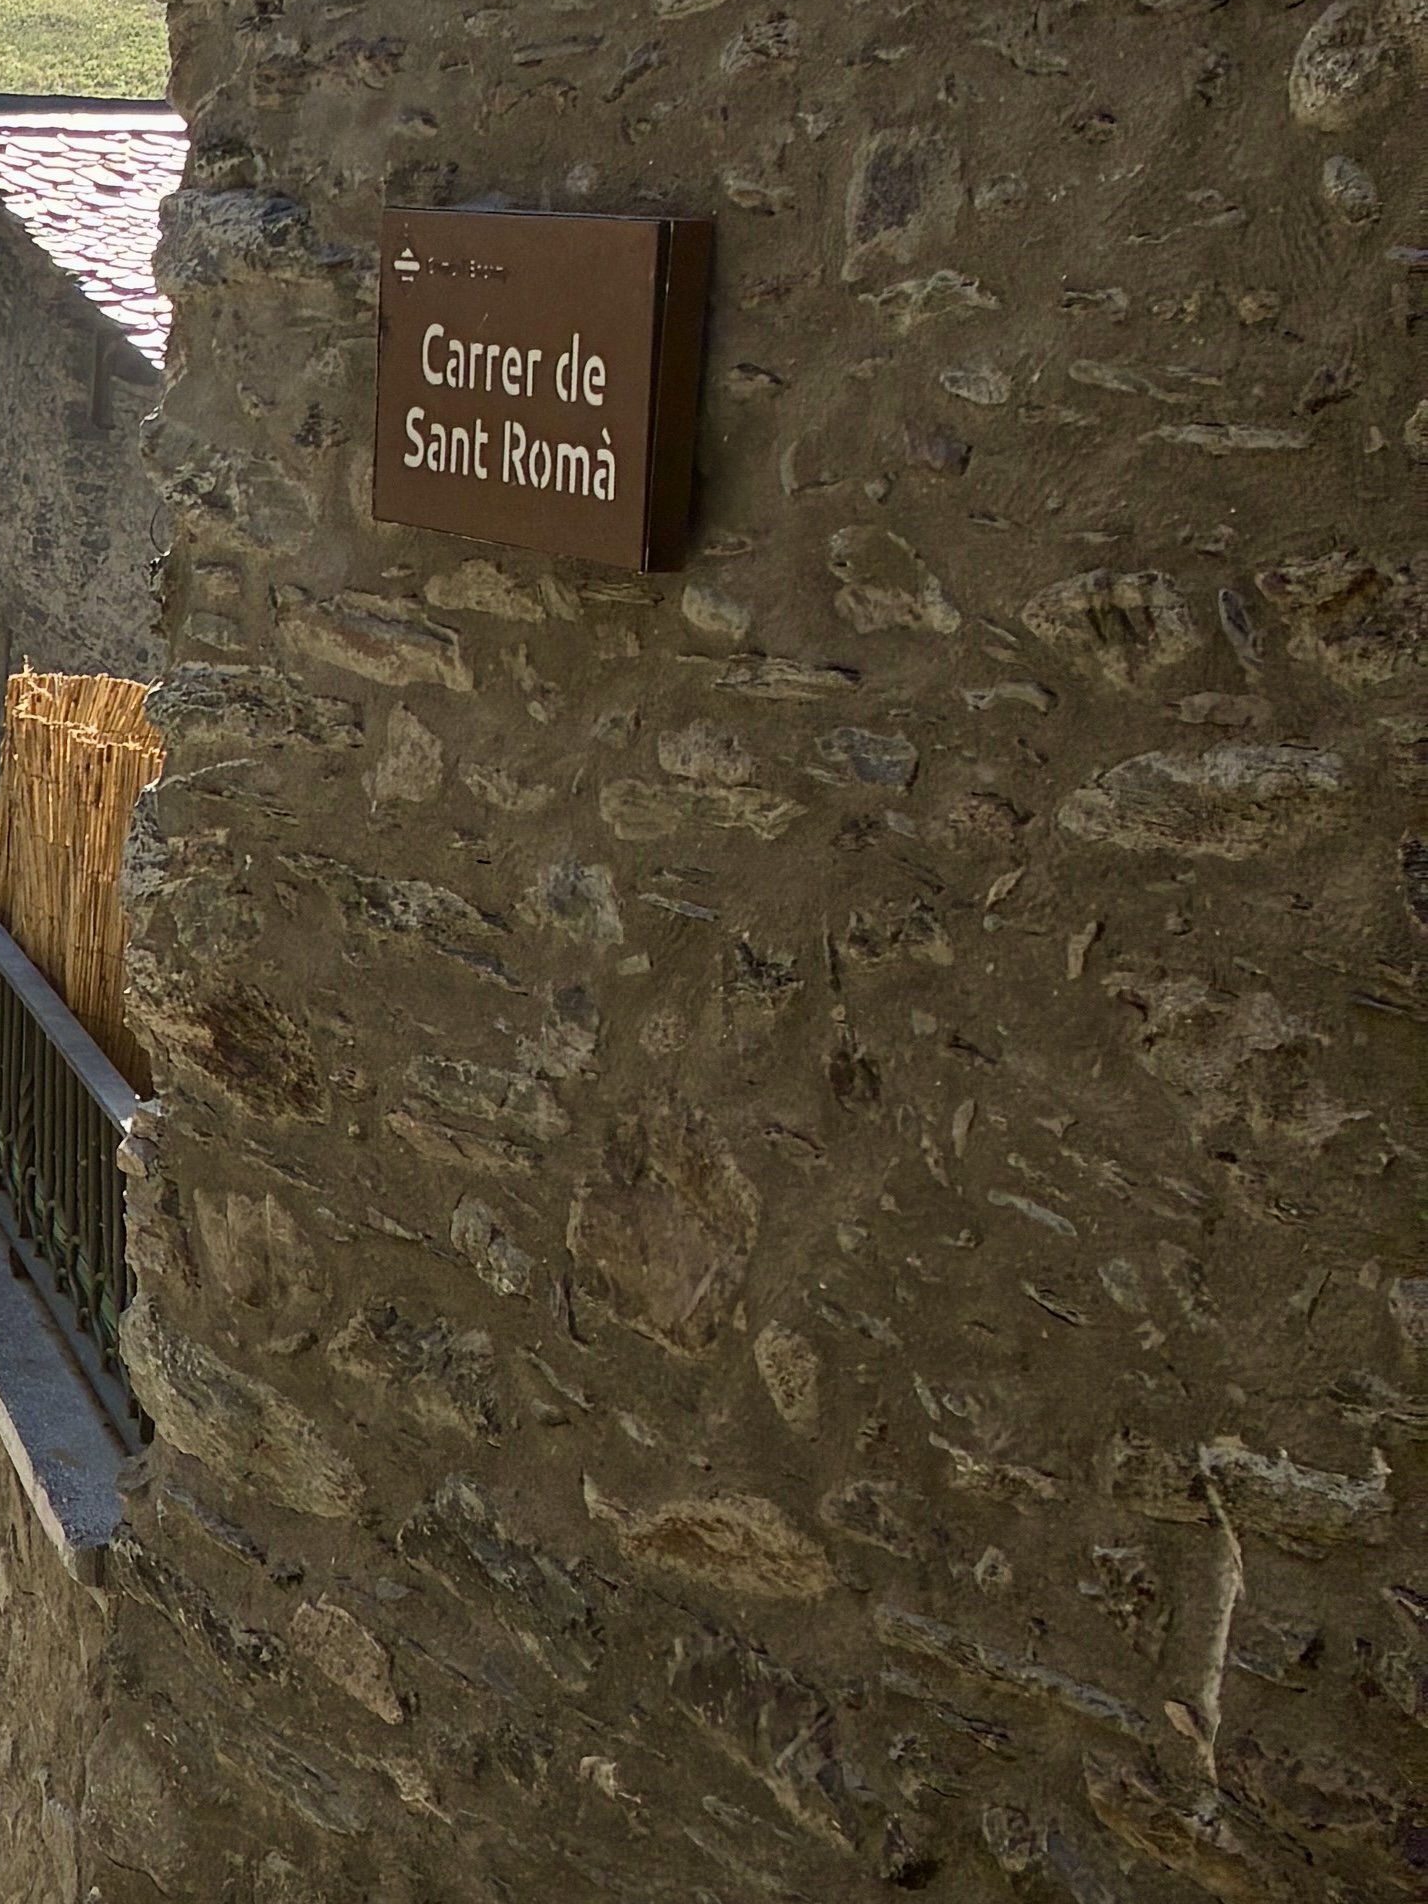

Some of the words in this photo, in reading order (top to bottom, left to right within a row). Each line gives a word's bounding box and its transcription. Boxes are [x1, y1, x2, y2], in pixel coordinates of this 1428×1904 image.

[422, 323, 542, 397] Carrer
[555, 332, 606, 406] de
[403, 406, 489, 480] Sant
[502, 420, 616, 501] Romà
